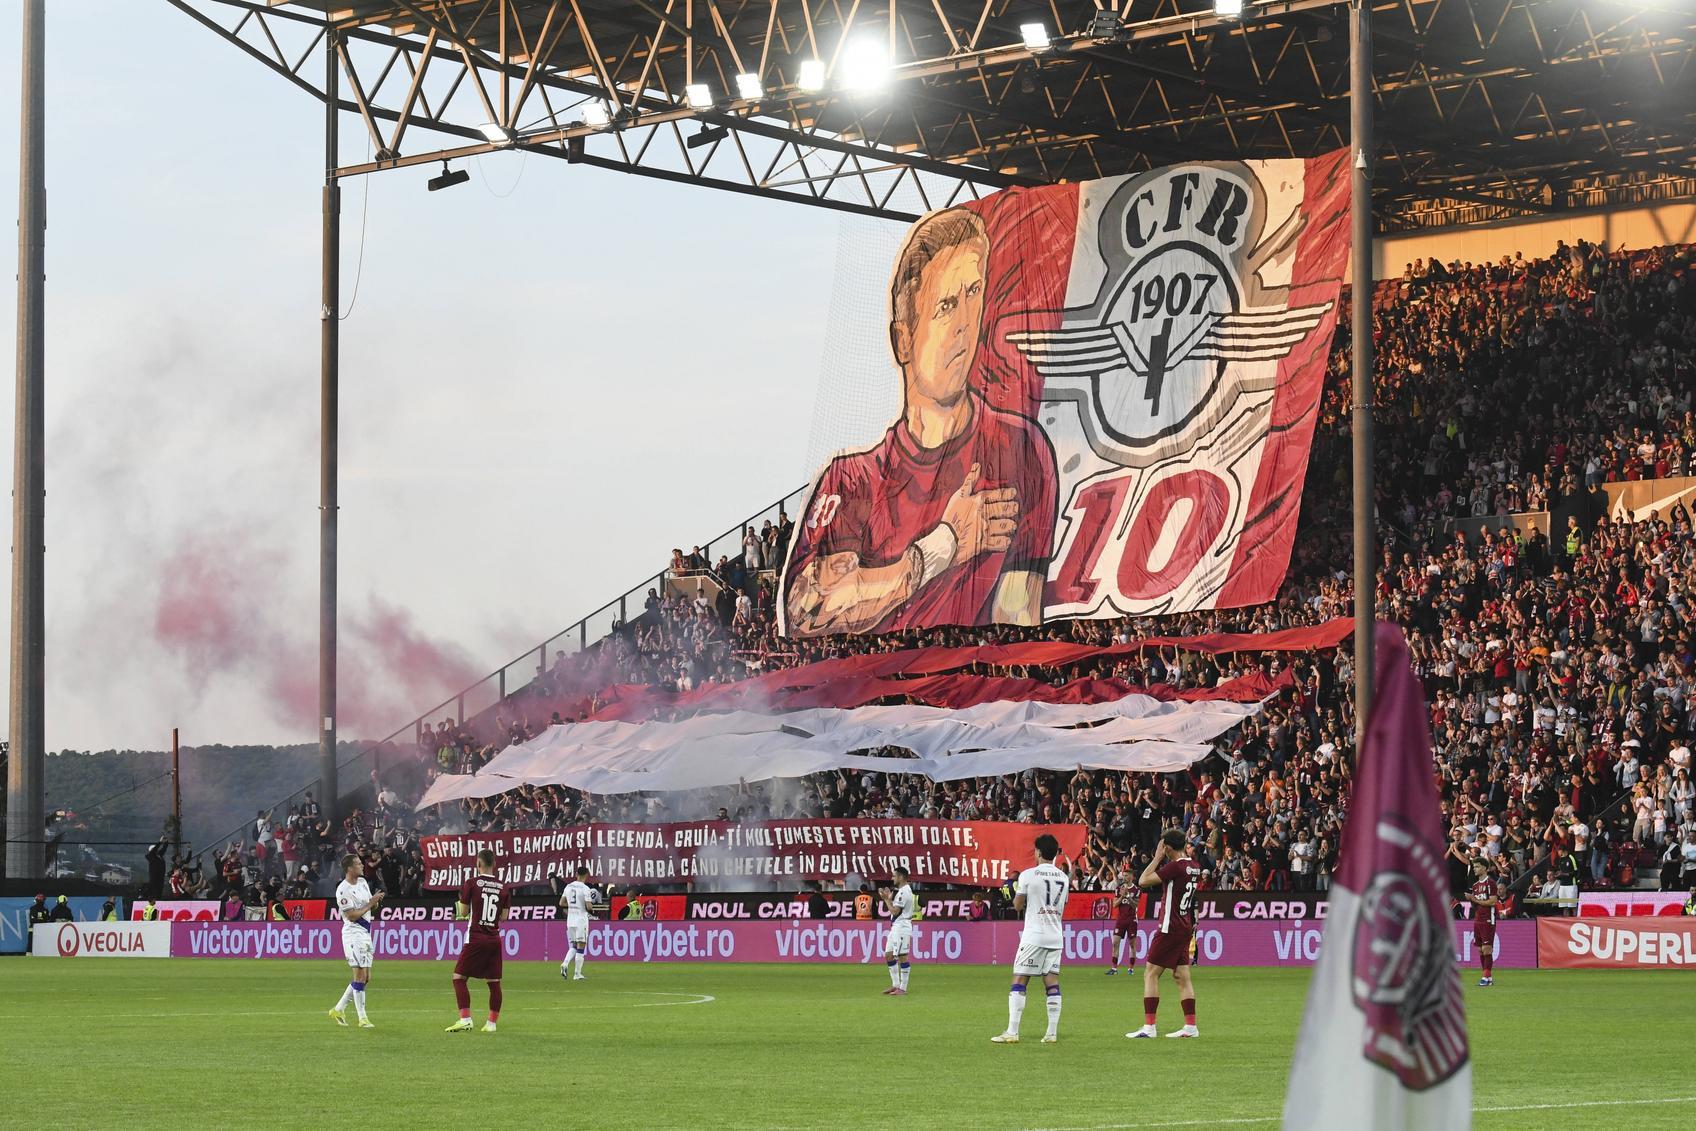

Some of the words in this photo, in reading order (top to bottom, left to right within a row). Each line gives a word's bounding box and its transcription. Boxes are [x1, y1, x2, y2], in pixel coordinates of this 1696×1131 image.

[1126, 173, 1248, 249] CFR
[1130, 272, 1218, 323] 1907
[1047, 469, 1230, 604] 10
[849, 826, 914, 845] PENTRU
[919, 826, 979, 850] TOATE,
[608, 858, 626, 877] PE
[1044, 880, 1065, 907] 17
[380, 907, 427, 920] CARD
[431, 907, 454, 920] DE
[481, 893, 500, 922] 16
[691, 902, 751, 918] NOUL
[1233, 901, 1307, 919] CARD
[83, 931, 145, 952] VEOLIA
[189, 921, 332, 959] victorybet.ro
